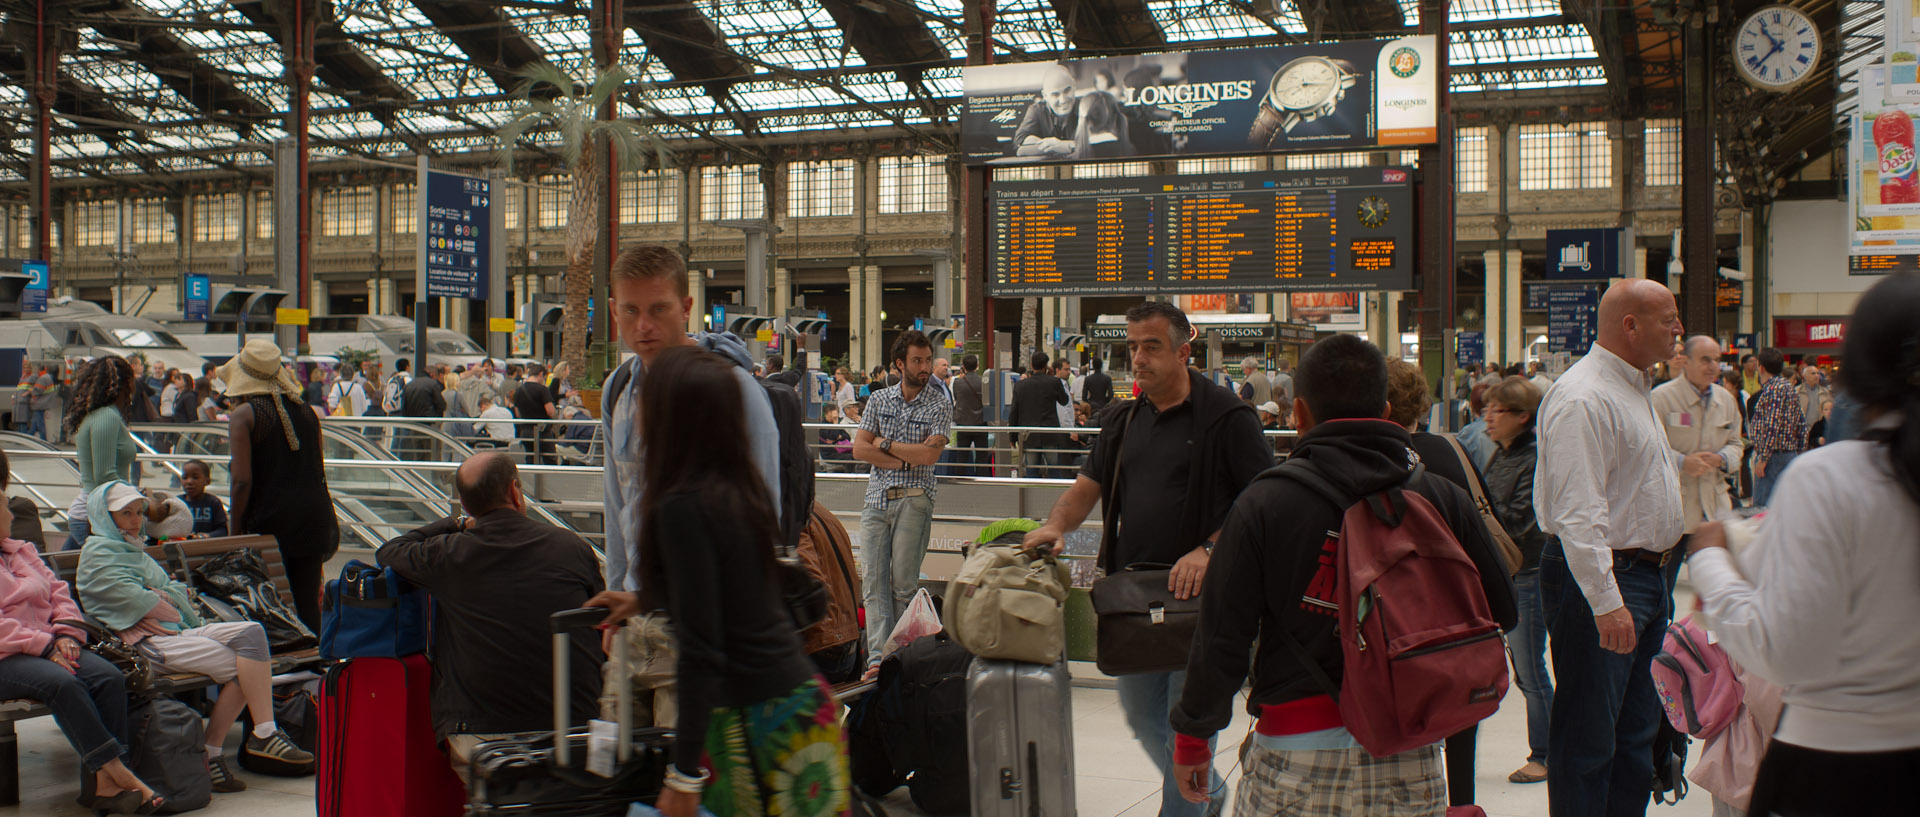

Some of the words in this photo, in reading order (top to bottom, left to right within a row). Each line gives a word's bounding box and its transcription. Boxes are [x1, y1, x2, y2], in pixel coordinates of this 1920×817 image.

[1124, 80, 1253, 106] LONGINES
[968, 96, 995, 104] Elegance
[1881, 148, 1915, 173] Oasis
[1384, 172, 1405, 182] SNCF
[996, 190, 1017, 198] Trains
[1031, 189, 1054, 198] départ
[429, 205, 446, 215] Sortie
[429, 267, 446, 275] Location
[29, 269, 41, 285] D
[193, 281, 201, 296] E
[1191, 294, 1226, 310] BIM
[716, 310, 722, 321] H
[1215, 328, 1263, 337] OISSONS
[1811, 323, 1842, 341] RELAY
